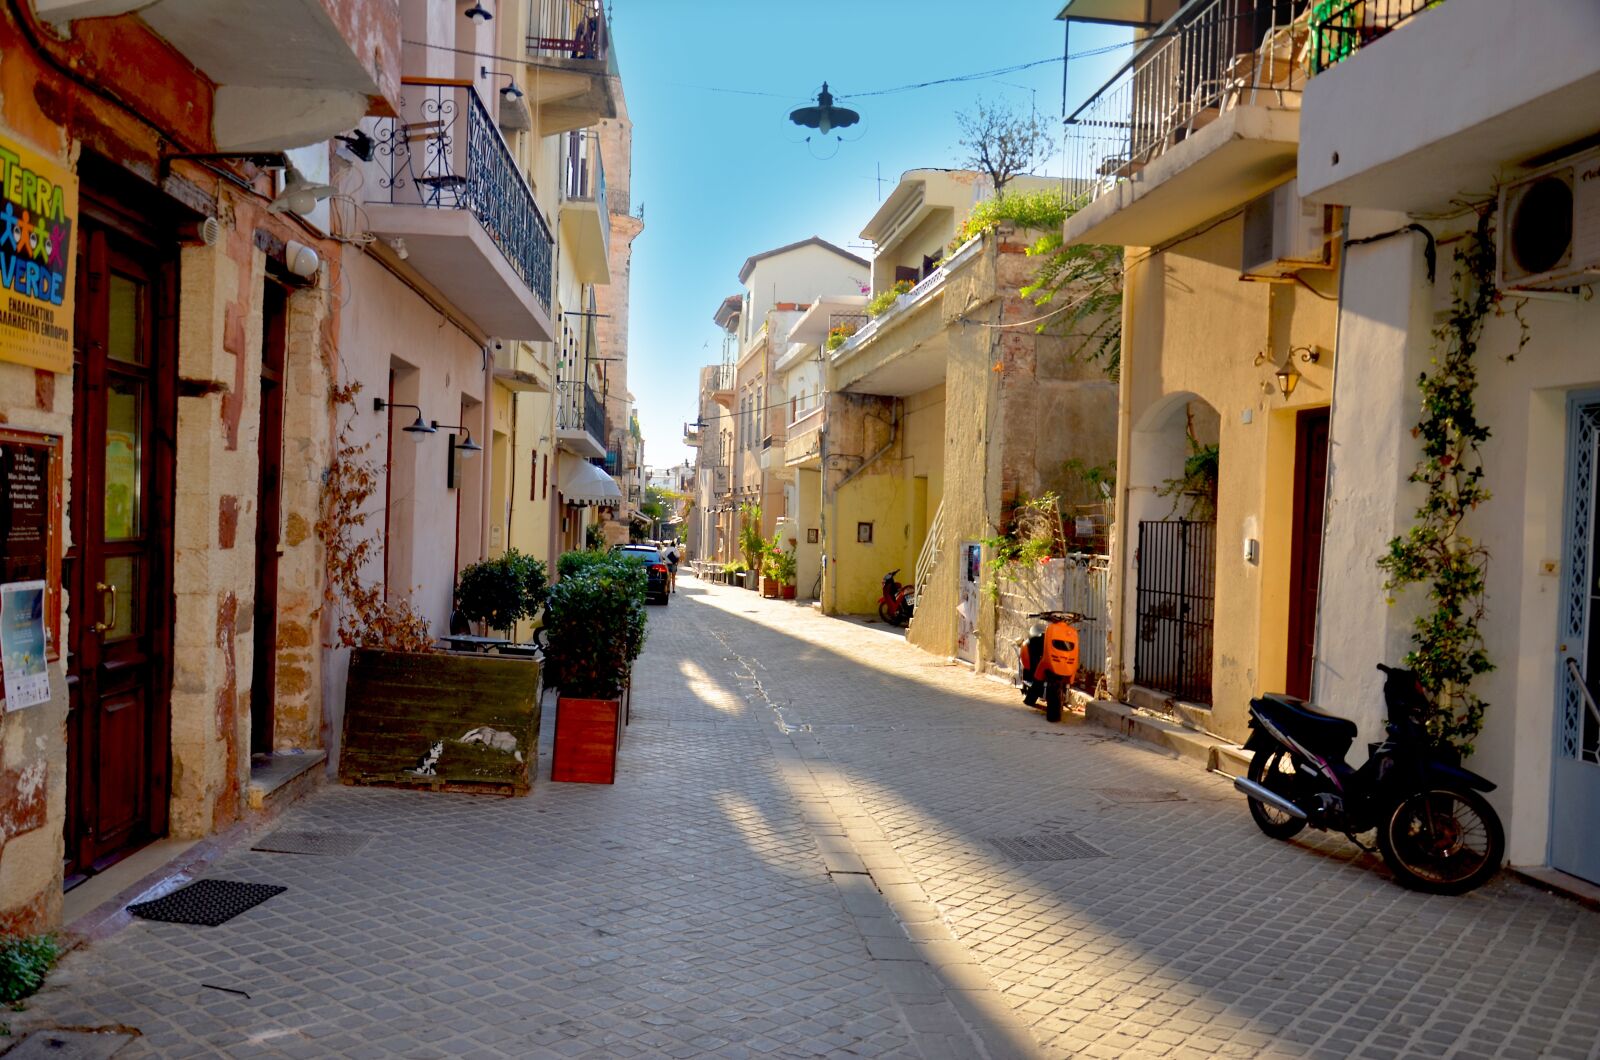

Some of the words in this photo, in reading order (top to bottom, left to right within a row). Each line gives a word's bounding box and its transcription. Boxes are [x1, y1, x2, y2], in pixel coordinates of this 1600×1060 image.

[0, 145, 65, 224] TERRA
[0, 250, 64, 306] VERDE
[9, 297, 54, 323] ΕΝΑΛΛΑΚΤΙΚΟ
[41, 321, 69, 342] ΕΜΠΟΡΙΟ
